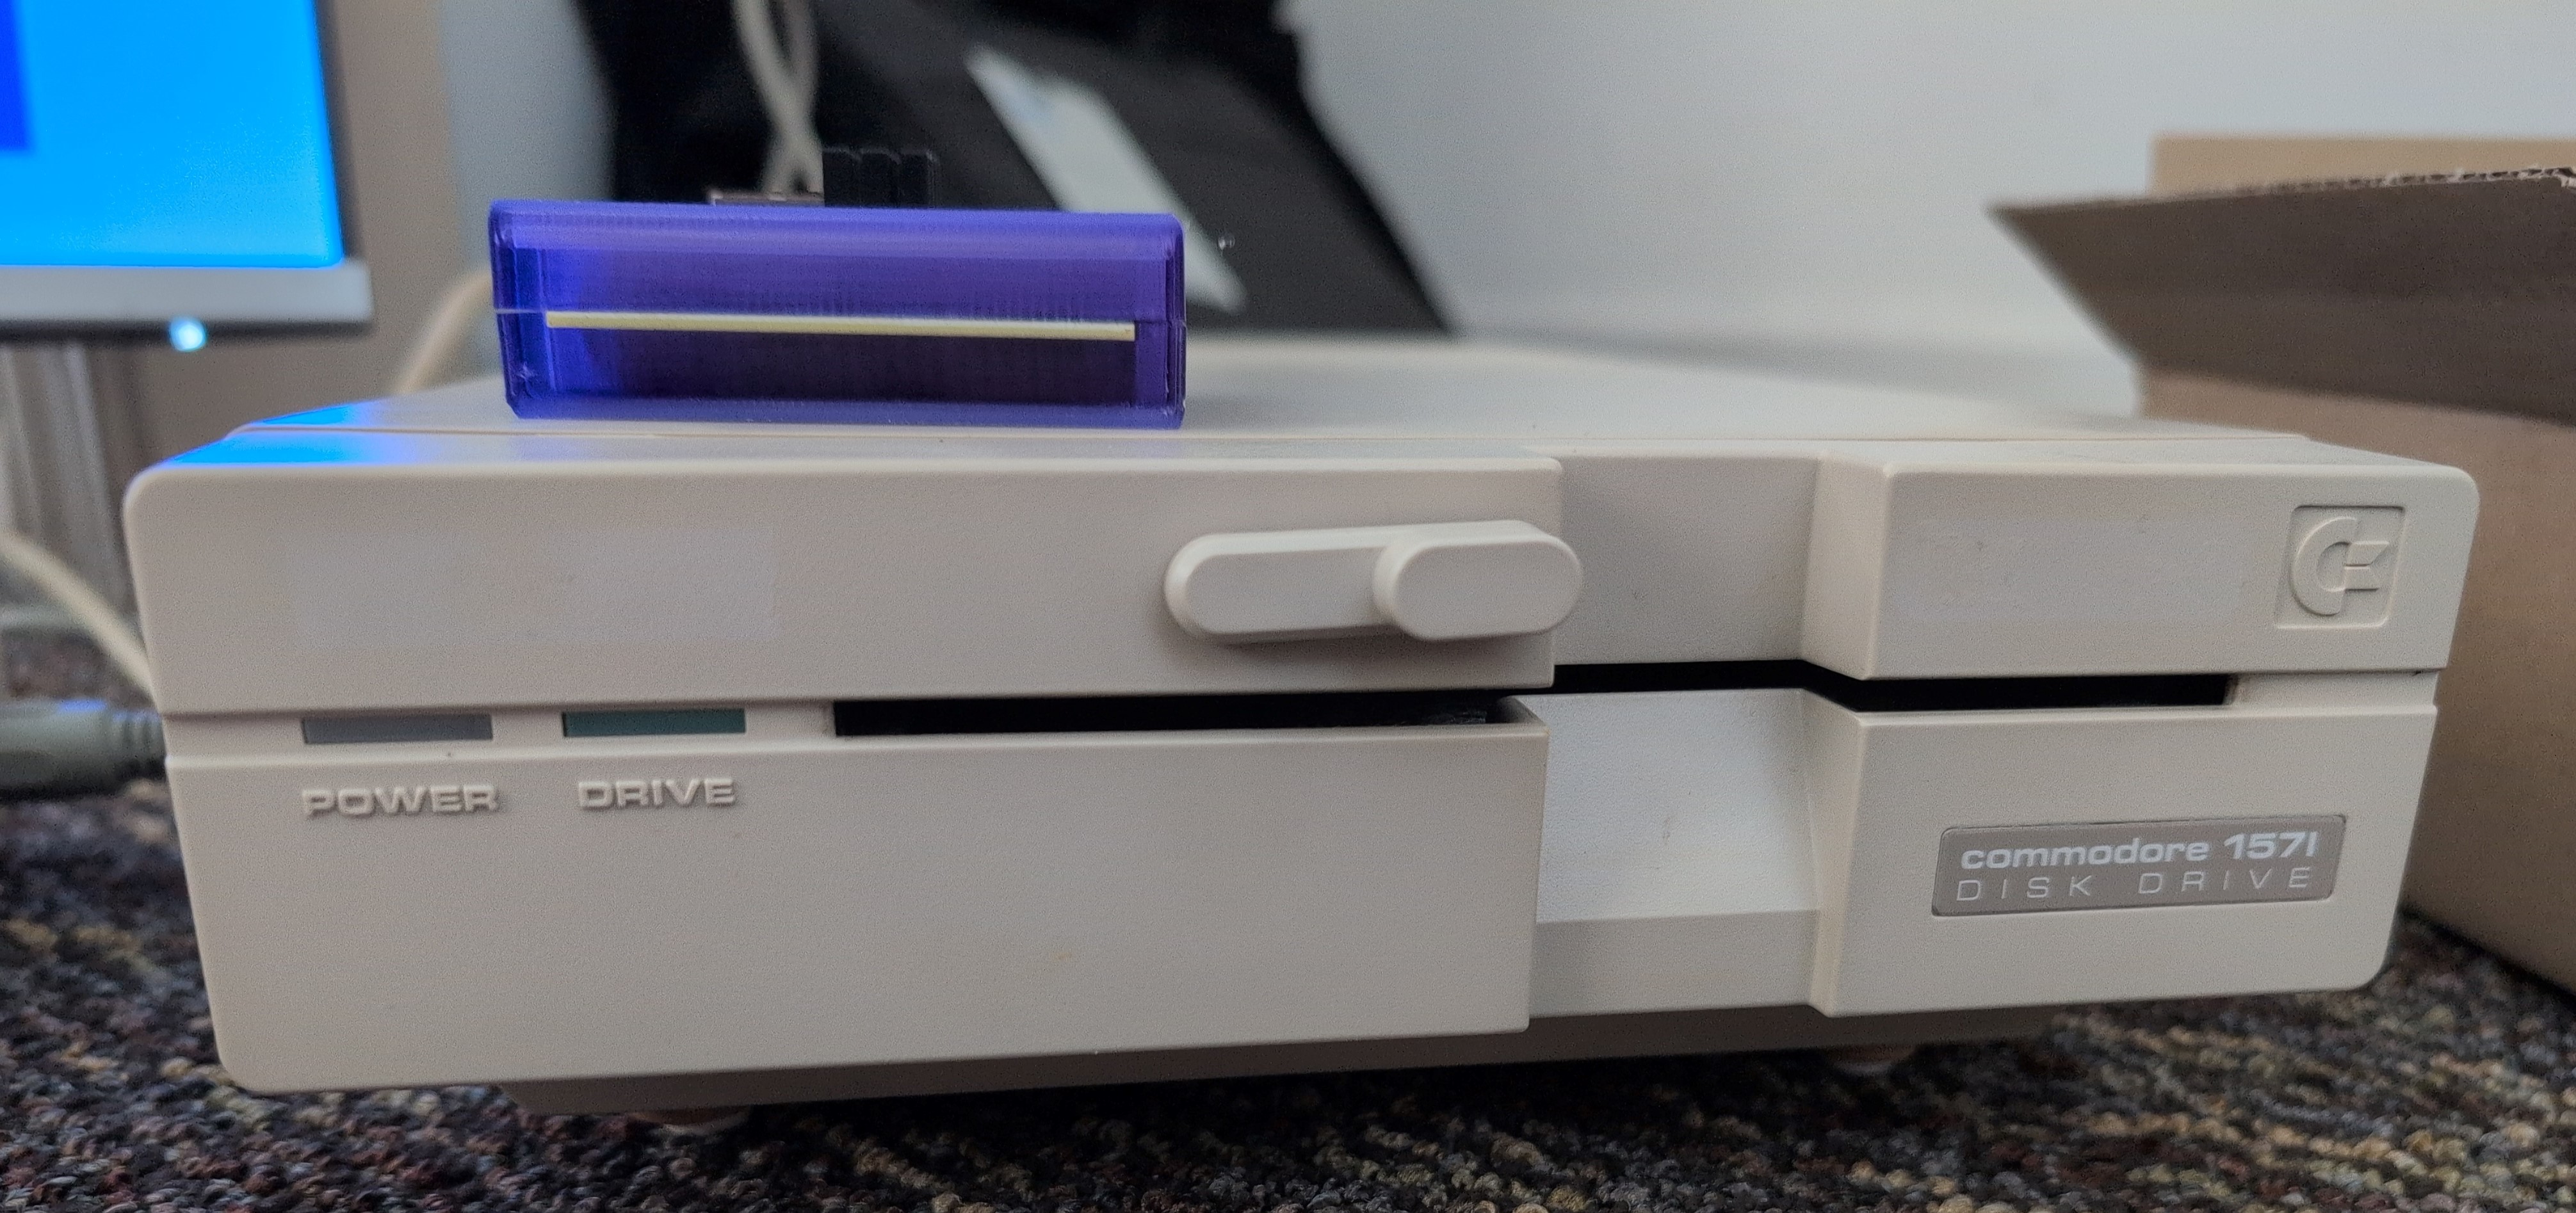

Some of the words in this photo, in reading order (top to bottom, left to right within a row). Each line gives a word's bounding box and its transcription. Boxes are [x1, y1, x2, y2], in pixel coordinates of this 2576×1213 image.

[302, 783, 499, 818] POWER
[578, 776, 736, 810] DRIVE
[1961, 838, 2210, 869] commodore
[2224, 831, 2319, 860] 1571
[1956, 875, 2093, 901] DISK
[2138, 867, 2311, 894] DRIVE
